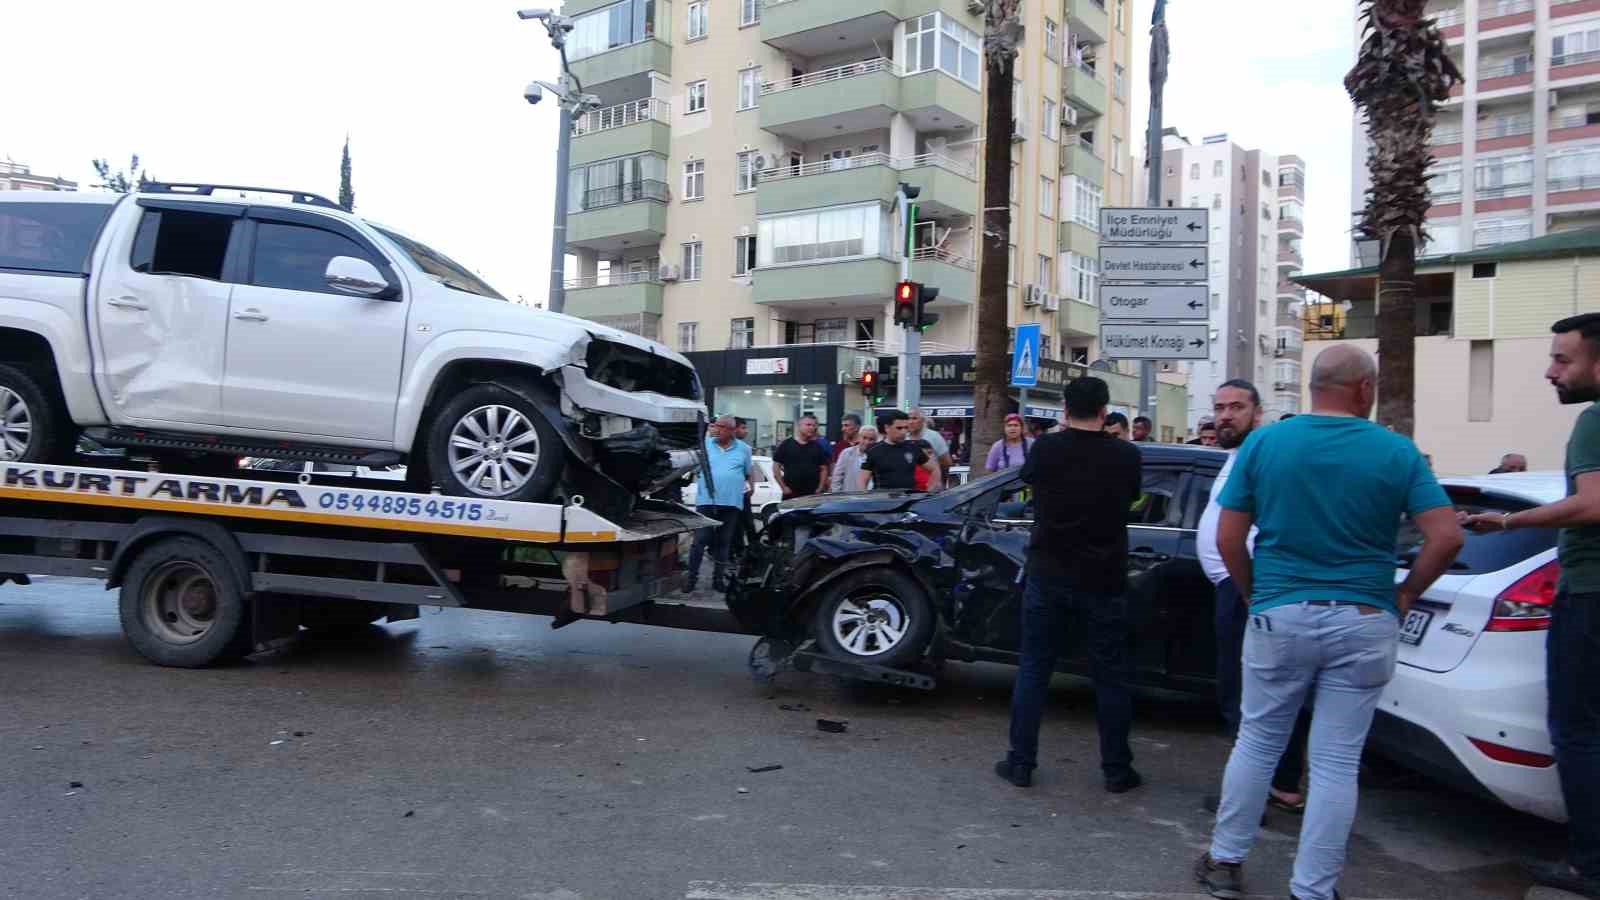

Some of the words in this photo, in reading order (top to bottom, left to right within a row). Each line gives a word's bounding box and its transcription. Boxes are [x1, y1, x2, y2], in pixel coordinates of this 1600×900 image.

[1131, 214, 1178, 227] Emniyet
[1110, 227, 1172, 240] Müdürlüğü
[1105, 260, 1131, 271] Devlet
[1110, 296, 1149, 309] Otogar
[1106, 334, 1148, 348] Hükümet
[889, 364, 956, 380] FKAN
[5, 467, 307, 508] KURTARMA
[1404, 613, 1425, 635] 81
